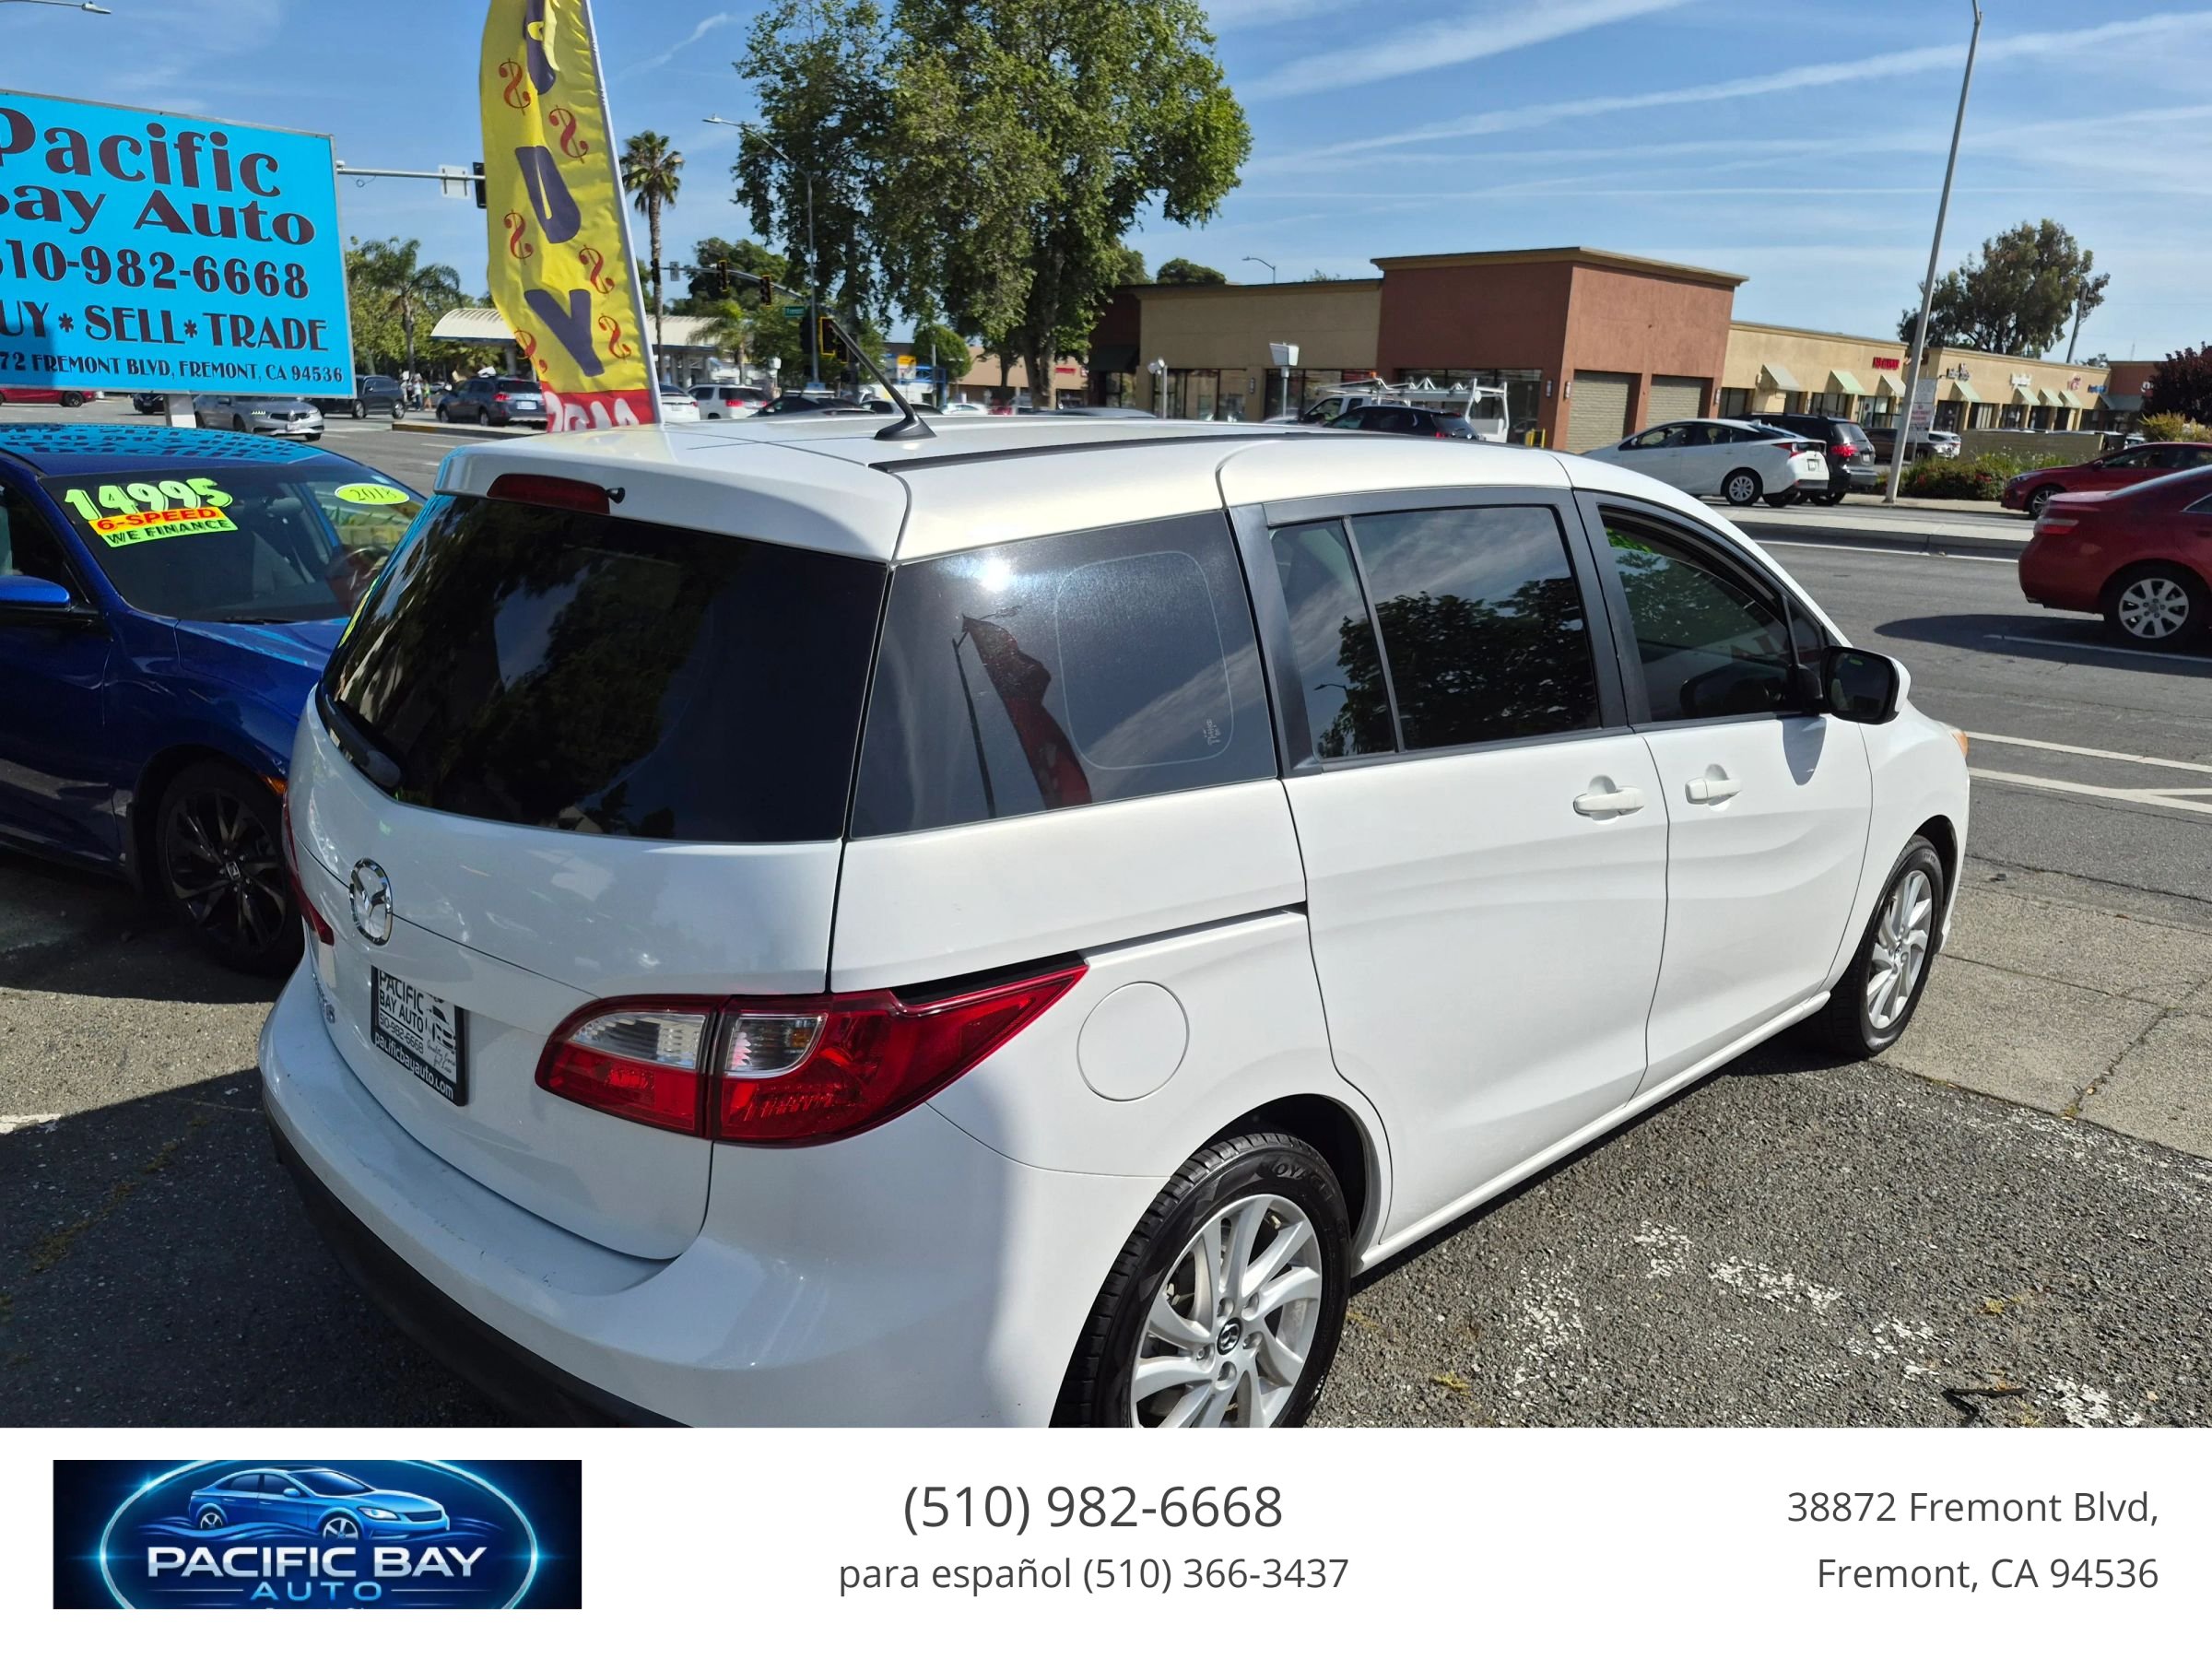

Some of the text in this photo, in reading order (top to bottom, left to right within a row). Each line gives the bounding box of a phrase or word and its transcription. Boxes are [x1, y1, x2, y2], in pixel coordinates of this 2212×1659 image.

[0, 185, 315, 245] ay Auto
[0, 240, 309, 299] 10-982-6668
[85, 305, 184, 345] SELL
[203, 312, 329, 351] TRADE
[31, 355, 121, 376] FREMONT
[127, 359, 175, 380] BLVD,
[179, 360, 261, 382] FREMONT,
[265, 364, 287, 381] CA
[291, 365, 343, 382] 94536
[65, 477, 232, 521] 14995
[96, 508, 218, 531] 6-SPEED
[106, 519, 231, 545] WE FINANCE
[379, 970, 424, 1015] PACIFIC
[380, 990, 424, 1033] BAY AUTO
[379, 1013, 424, 1054] 510-982-6668
[374, 1032, 453, 1100] pacificbayauto.com
